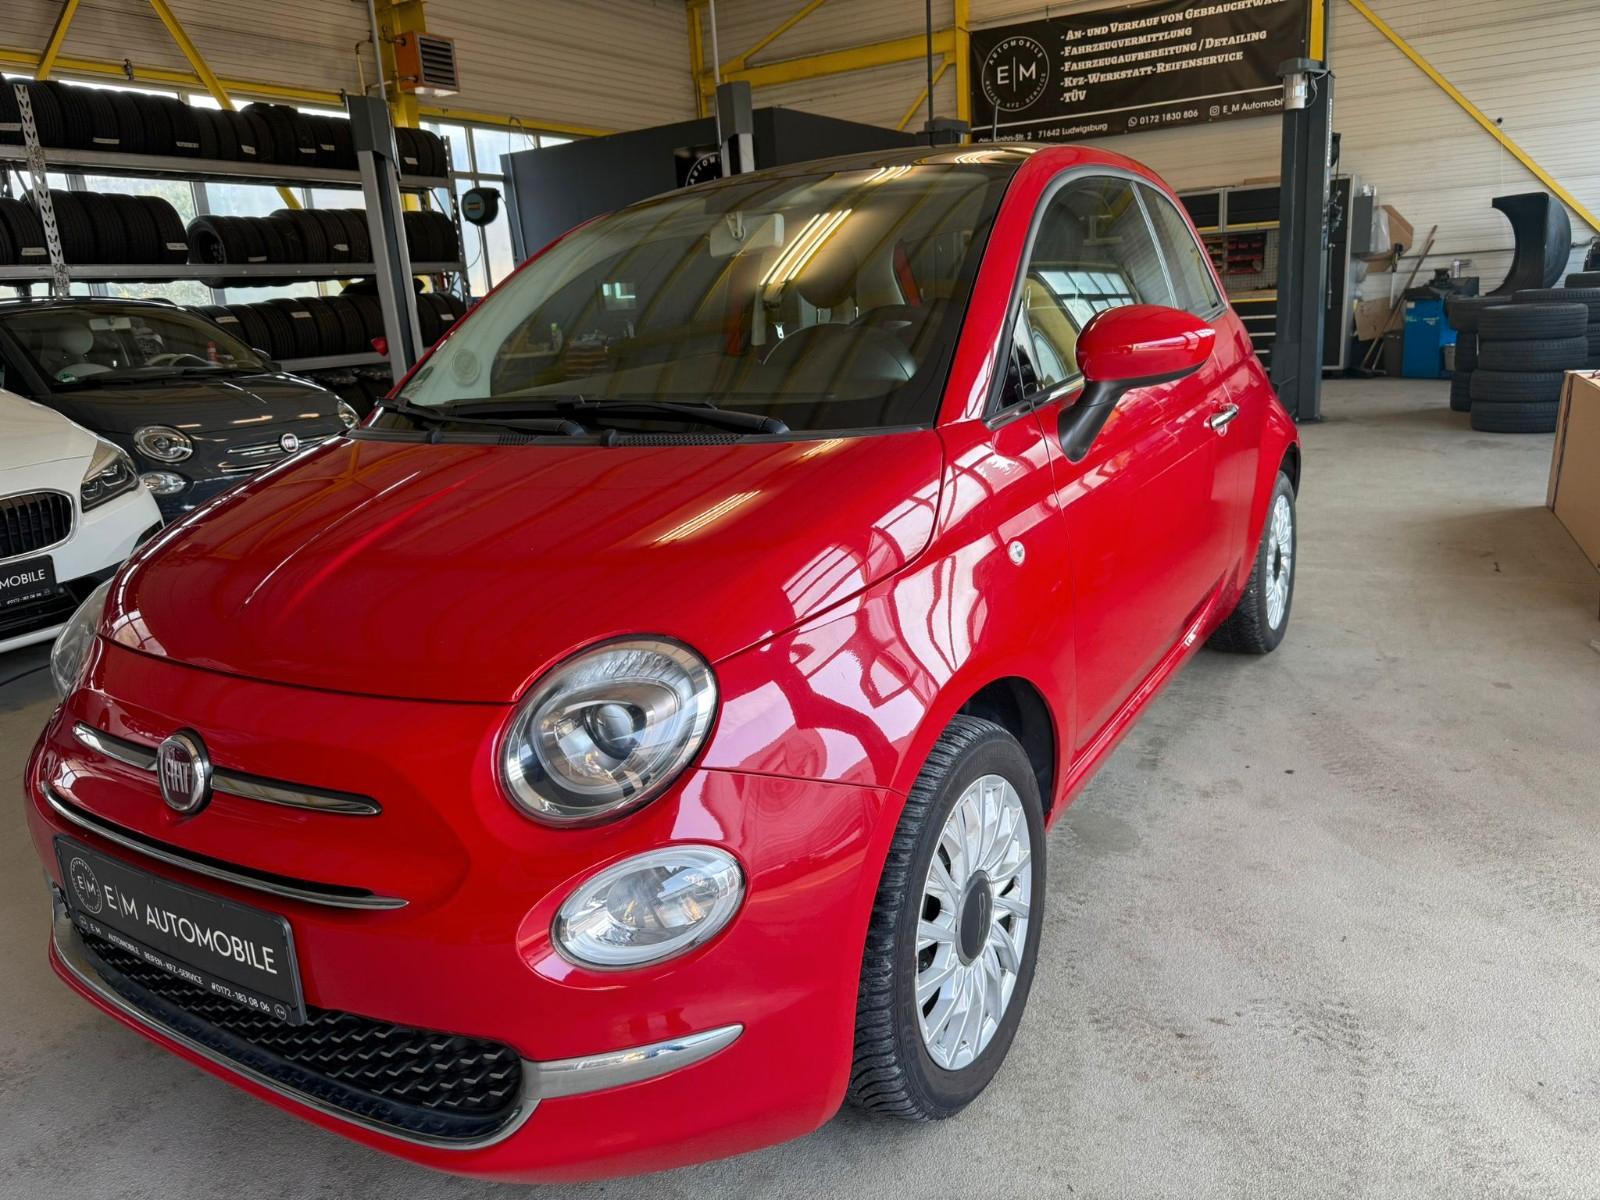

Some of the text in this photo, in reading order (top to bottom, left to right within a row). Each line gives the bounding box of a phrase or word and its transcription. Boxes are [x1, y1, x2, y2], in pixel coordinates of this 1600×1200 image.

[1110, 16, 1160, 33] VERKAUF
[1161, 11, 1184, 24] VON
[1205, 30, 1267, 49] DETAILING
[988, 39, 1043, 66] AUTOMOBILE
[1139, 114, 1160, 125] 0172
[1162, 112, 1181, 122] 1830
[1183, 110, 1199, 119] 806
[1038, 128, 1060, 138] 71642
[1062, 123, 1108, 136] Ludwigsburg
[165, 758, 189, 794] FIAT
[146, 904, 278, 975] AUTOMOBILE
